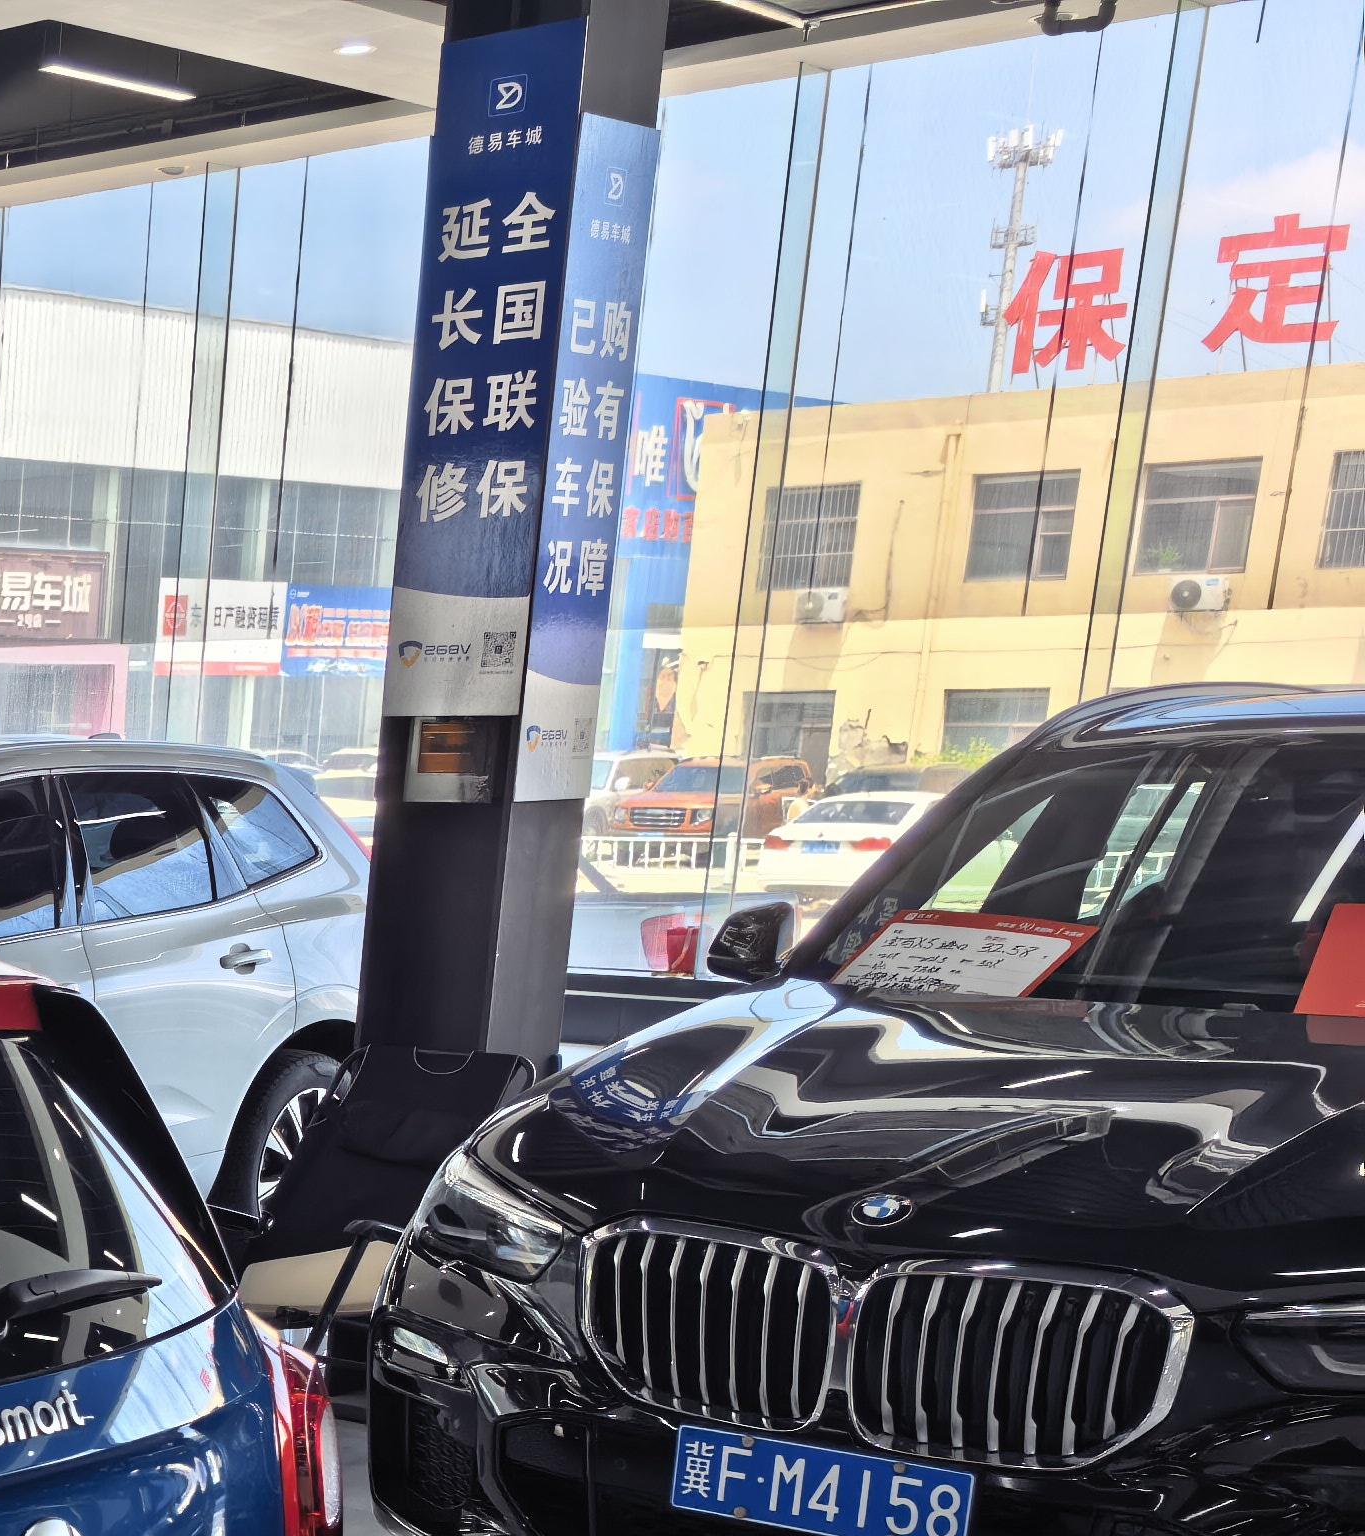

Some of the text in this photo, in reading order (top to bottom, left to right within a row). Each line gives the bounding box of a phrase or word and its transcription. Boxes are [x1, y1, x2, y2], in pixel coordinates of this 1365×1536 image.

[467, 126, 543, 155] 德易车城
[590, 219, 632, 245] 德易车城
[415, 198, 492, 523] 延长保修
[476, 191, 556, 518] 全国联保
[1004, 213, 1351, 375] 保定
[542, 298, 596, 595] 已验车况
[576, 300, 632, 597] 购有保障
[424, 643, 472, 656] 268V
